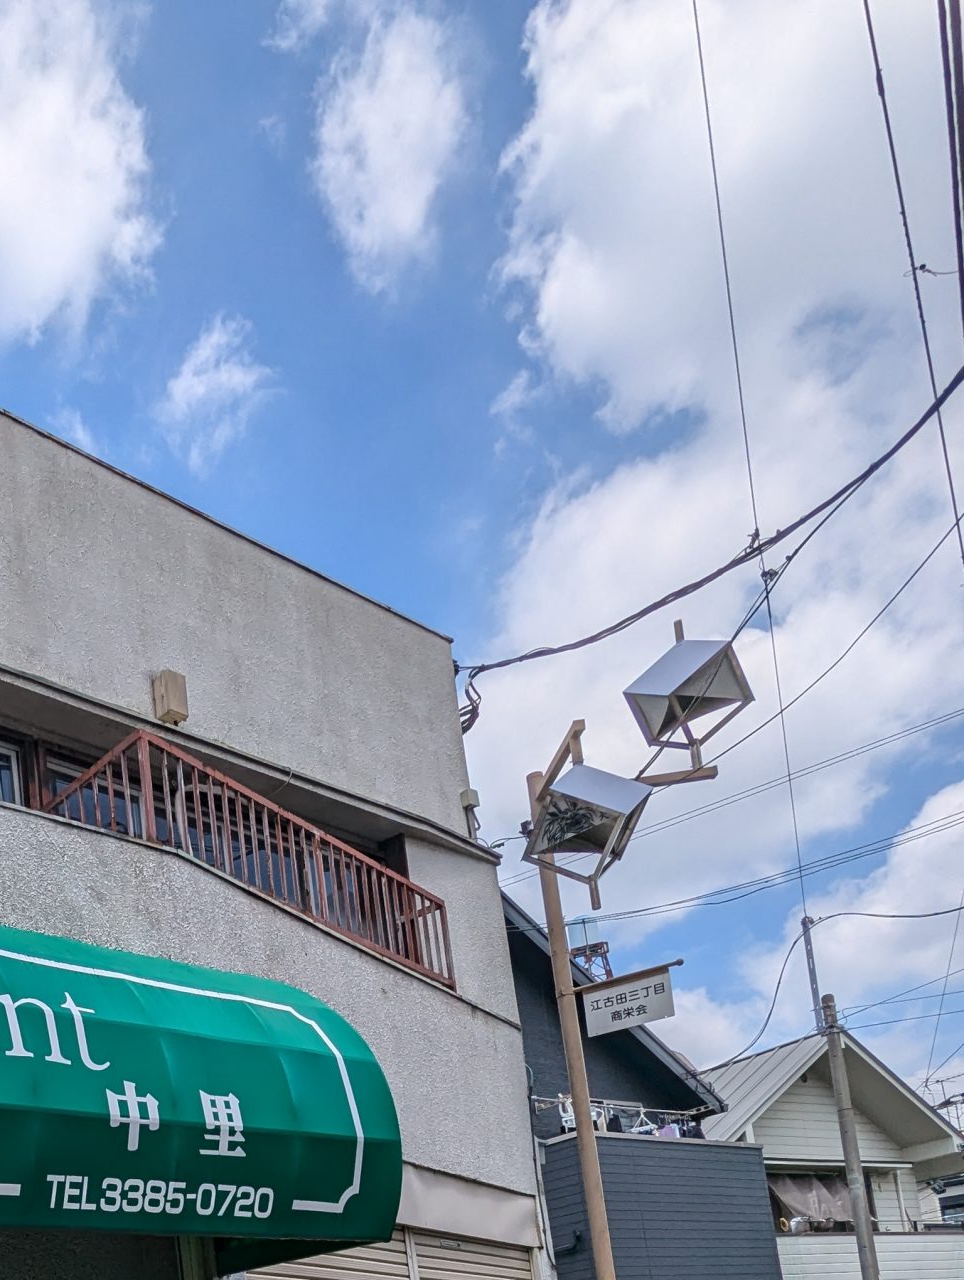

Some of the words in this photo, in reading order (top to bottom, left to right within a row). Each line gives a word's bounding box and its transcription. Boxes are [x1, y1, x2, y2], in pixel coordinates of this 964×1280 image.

[590, 982, 665, 1012] 江古田三丁目
[610, 1004, 648, 1022] 商栄会
[105, 1080, 247, 1158] 中里
